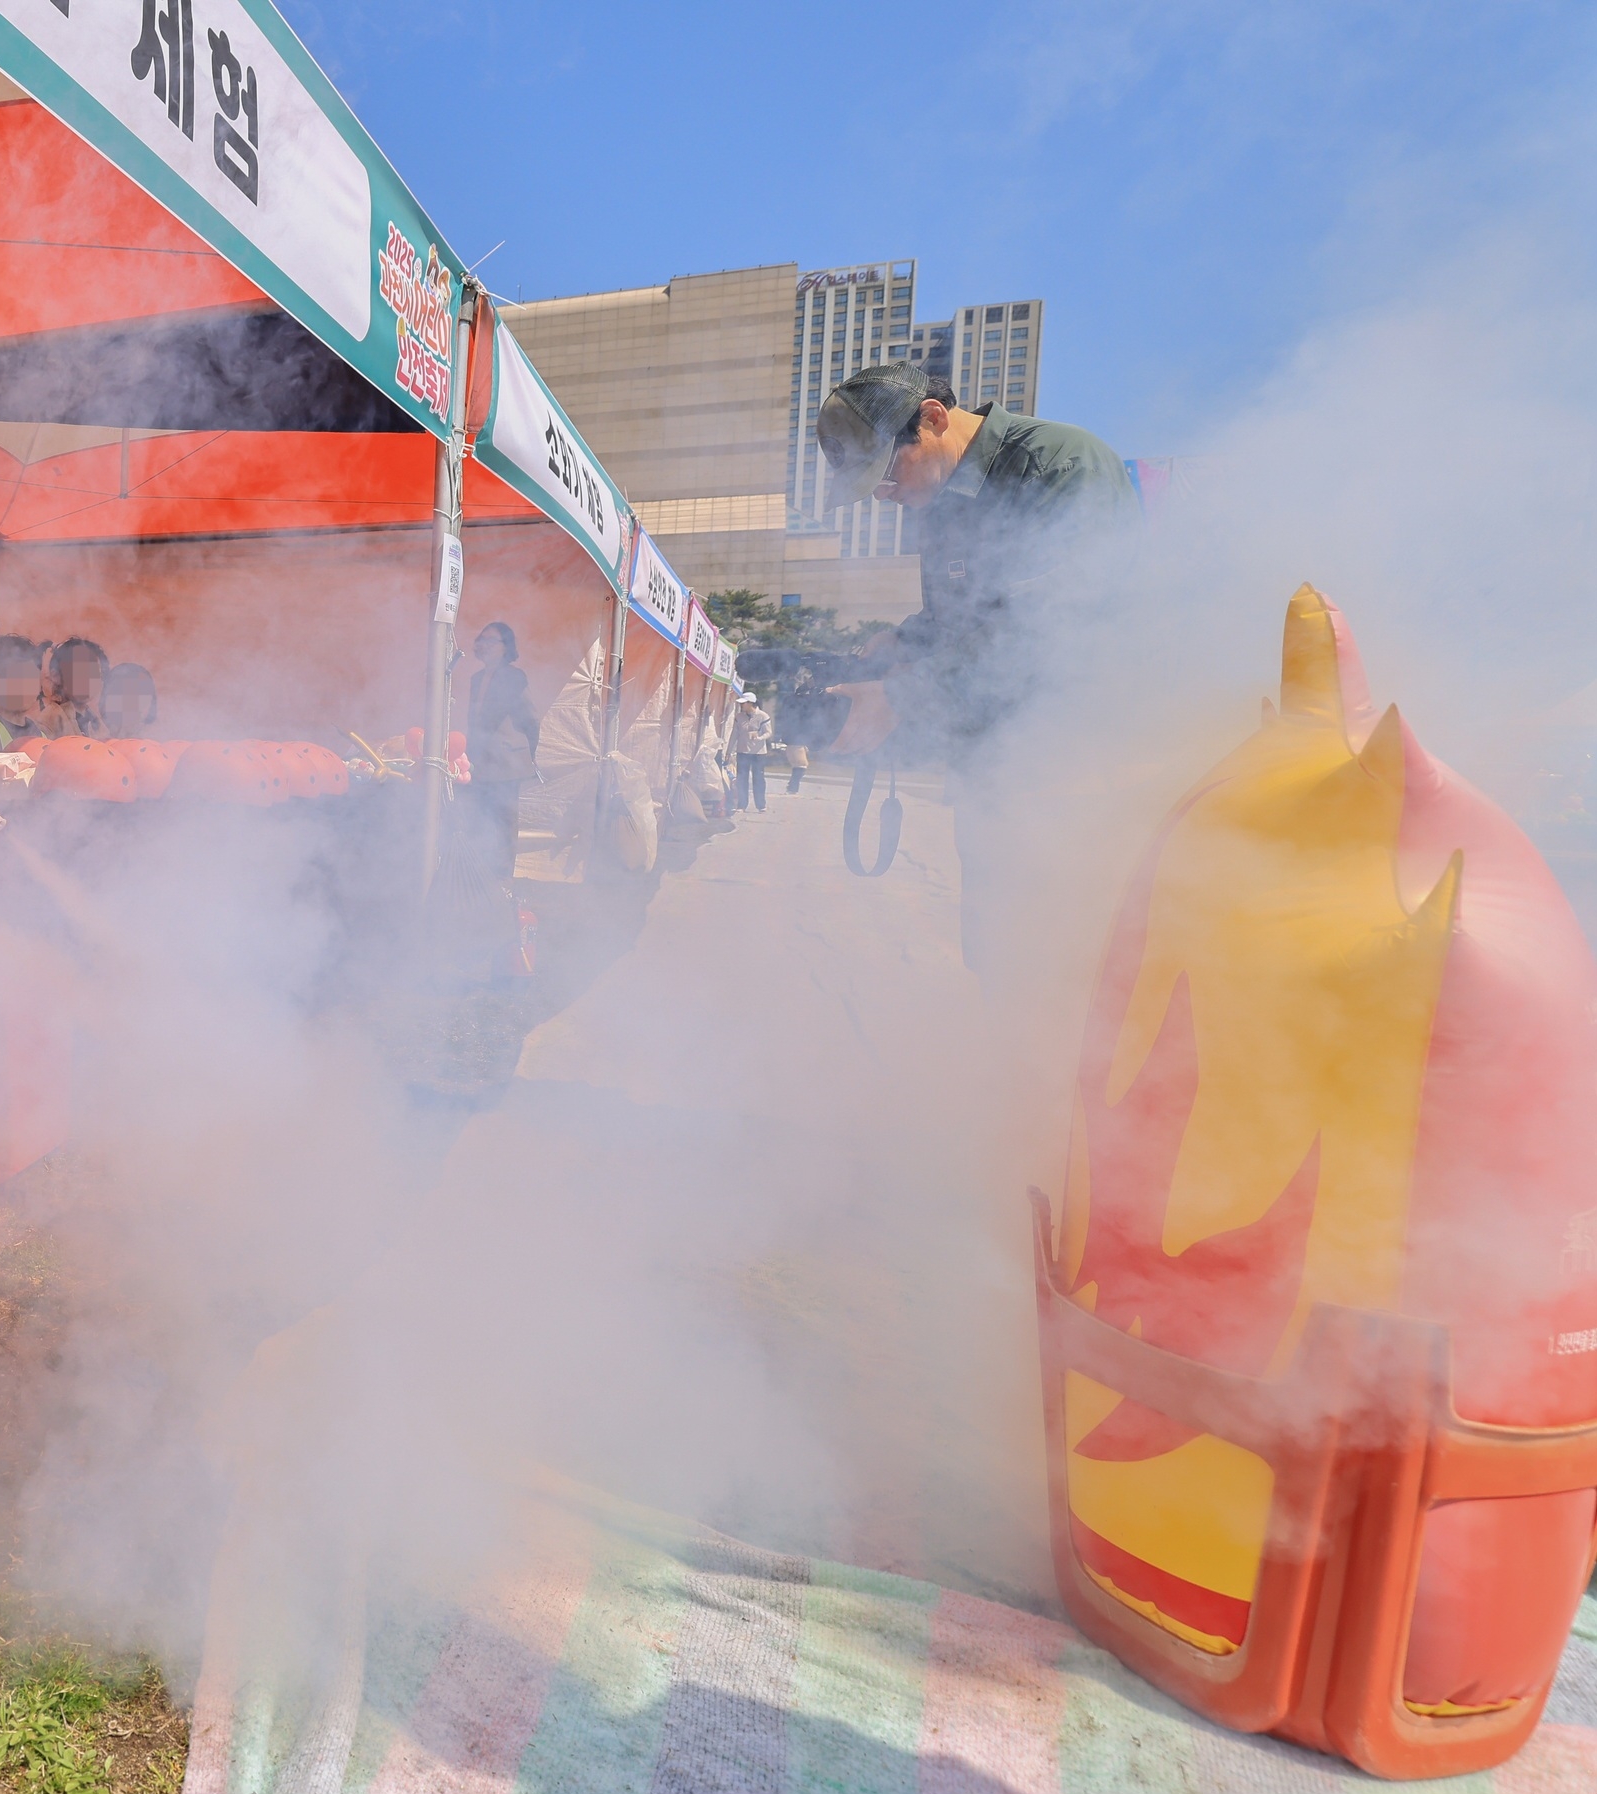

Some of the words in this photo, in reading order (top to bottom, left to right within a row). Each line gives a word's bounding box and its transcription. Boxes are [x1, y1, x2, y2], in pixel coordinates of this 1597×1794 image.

[387, 223, 414, 281] 2025
[396, 333, 451, 420] 안전축제
[545, 409, 584, 509] 소화기
